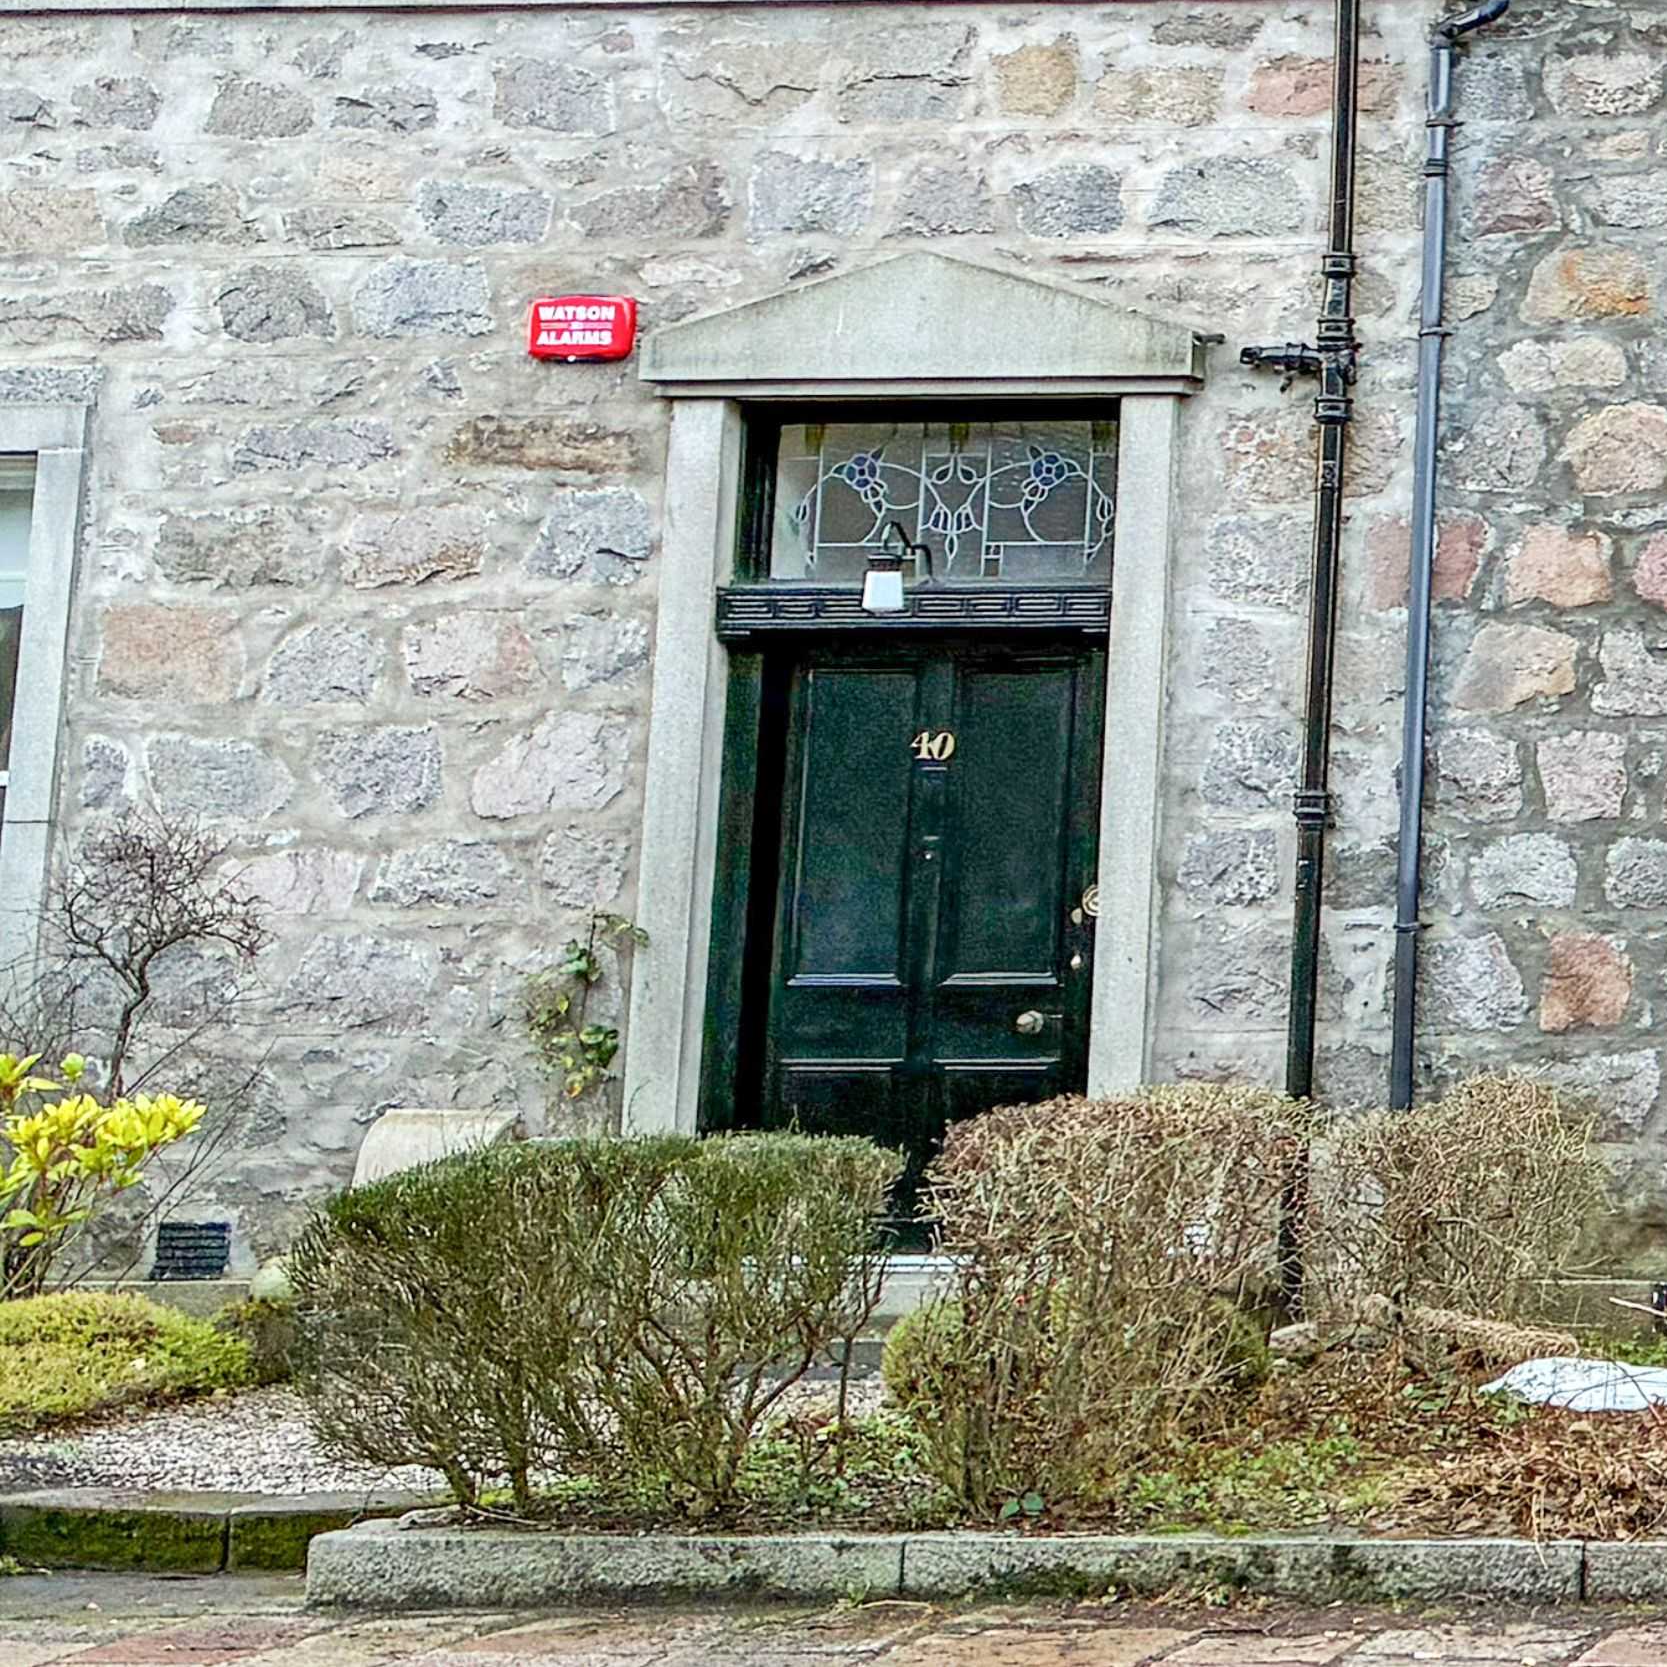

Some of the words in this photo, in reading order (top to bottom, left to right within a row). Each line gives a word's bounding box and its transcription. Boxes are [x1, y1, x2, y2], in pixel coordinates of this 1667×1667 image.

[538, 305, 616, 321] WATSON
[536, 330, 613, 346] ALARMS
[909, 731, 955, 761] 40
